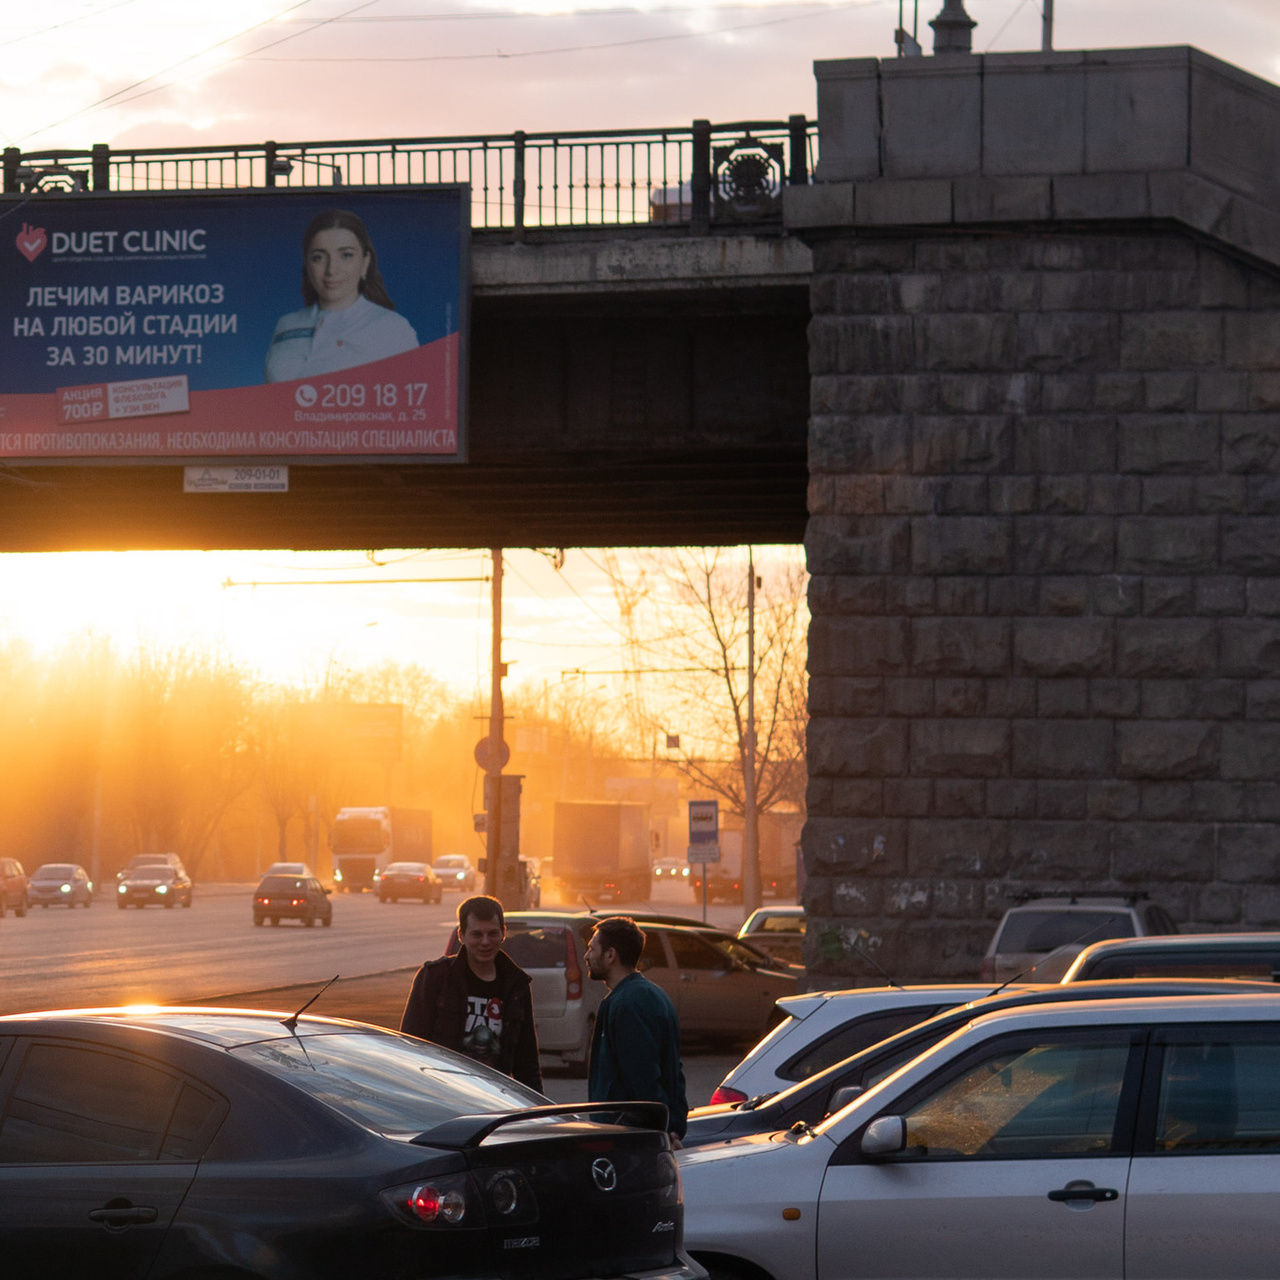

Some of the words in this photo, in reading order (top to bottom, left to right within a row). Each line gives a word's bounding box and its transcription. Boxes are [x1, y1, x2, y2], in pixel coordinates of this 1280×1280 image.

[51, 231, 119, 254] DUET
[122, 229, 206, 253] CLINIC
[27, 285, 109, 308] ЛЕЧИМ
[116, 283, 225, 306] ВАРИКОЗ
[14, 317, 45, 337] НА
[51, 311, 135, 337] ЛЮБОЙ
[143, 314, 238, 339] СТАДИИ
[46, 347, 75, 366] ЗА
[82, 346, 109, 366] 30
[116, 344, 202, 365] МИНУТ!
[62, 387, 103, 401] АКЦИЯ
[112, 379, 183, 394] КОНСУЛЬТАЦИЯ
[322, 384, 366, 407] 209
[373, 384, 397, 407] 18
[405, 383, 428, 407] 17
[294, 410, 395, 424] Владимировская,
[413, 409, 427, 421] 25
[25, 432, 163, 452] ПРОТИВОПОКАЗАНИЯ,
[167, 431, 256, 451] НЕОБХОДИМА
[260, 430, 358, 451] КОНСУЛЬТАЦИЯ
[362, 429, 455, 449] СПЕЦИАЛИСТА
[234, 468, 280, 480] 209-01-01
